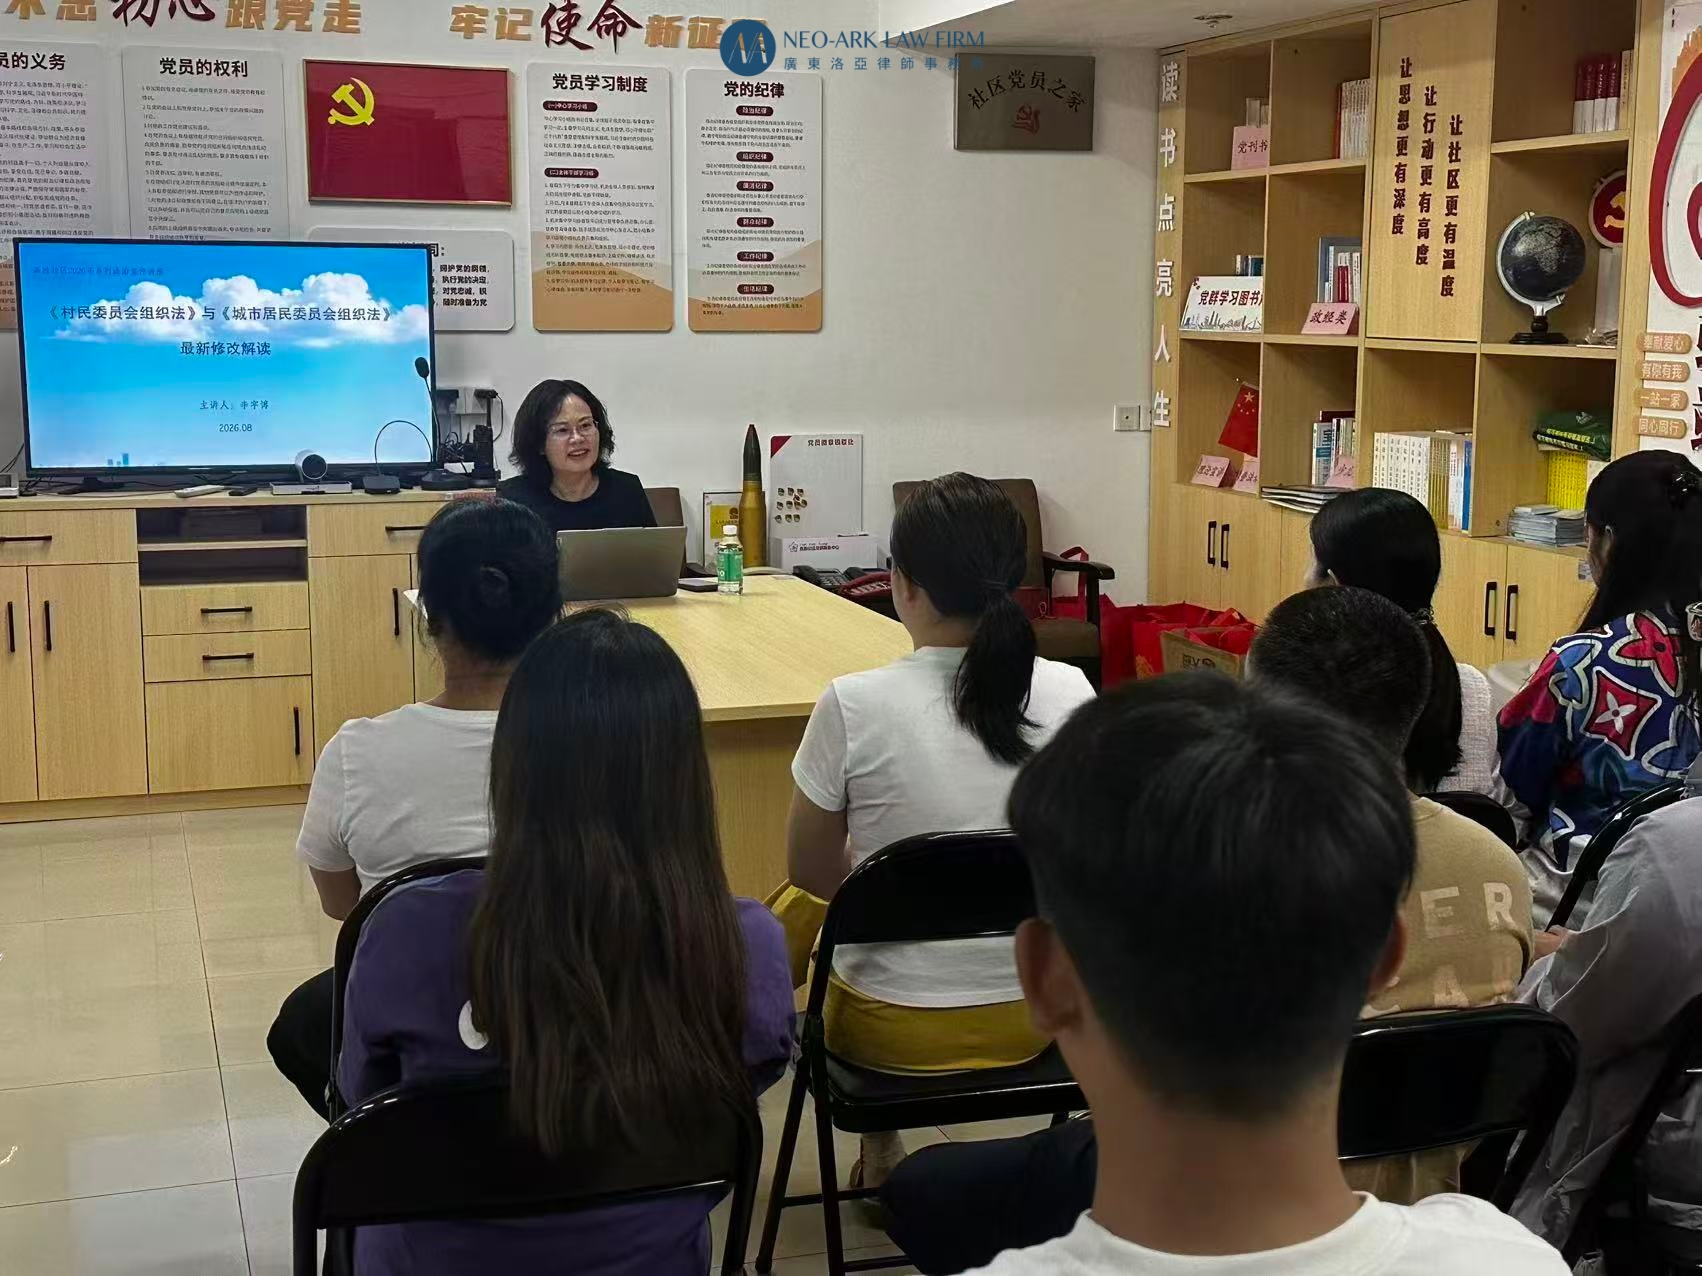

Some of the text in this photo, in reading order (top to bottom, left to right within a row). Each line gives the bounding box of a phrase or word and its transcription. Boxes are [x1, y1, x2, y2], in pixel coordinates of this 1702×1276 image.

[449, 0, 769, 54] 牢记使命新征
[159, 57, 249, 77] 党员的权利
[552, 73, 648, 93] 党员学习制度
[724, 81, 785, 98] 党的纪律
[967, 69, 1088, 113] 社区党员之家
[1391, 57, 1413, 235] 让思想更有深度
[1415, 85, 1438, 266] 让行动更有高度
[1440, 114, 1463, 297] 让社区更有温度
[1153, 61, 1180, 428] 读书点亮人生
[1199, 290, 1264, 306] 党群学习图书
[180, 341, 271, 356] 最新修改解读
[218, 423, 253, 433] 2026.08
